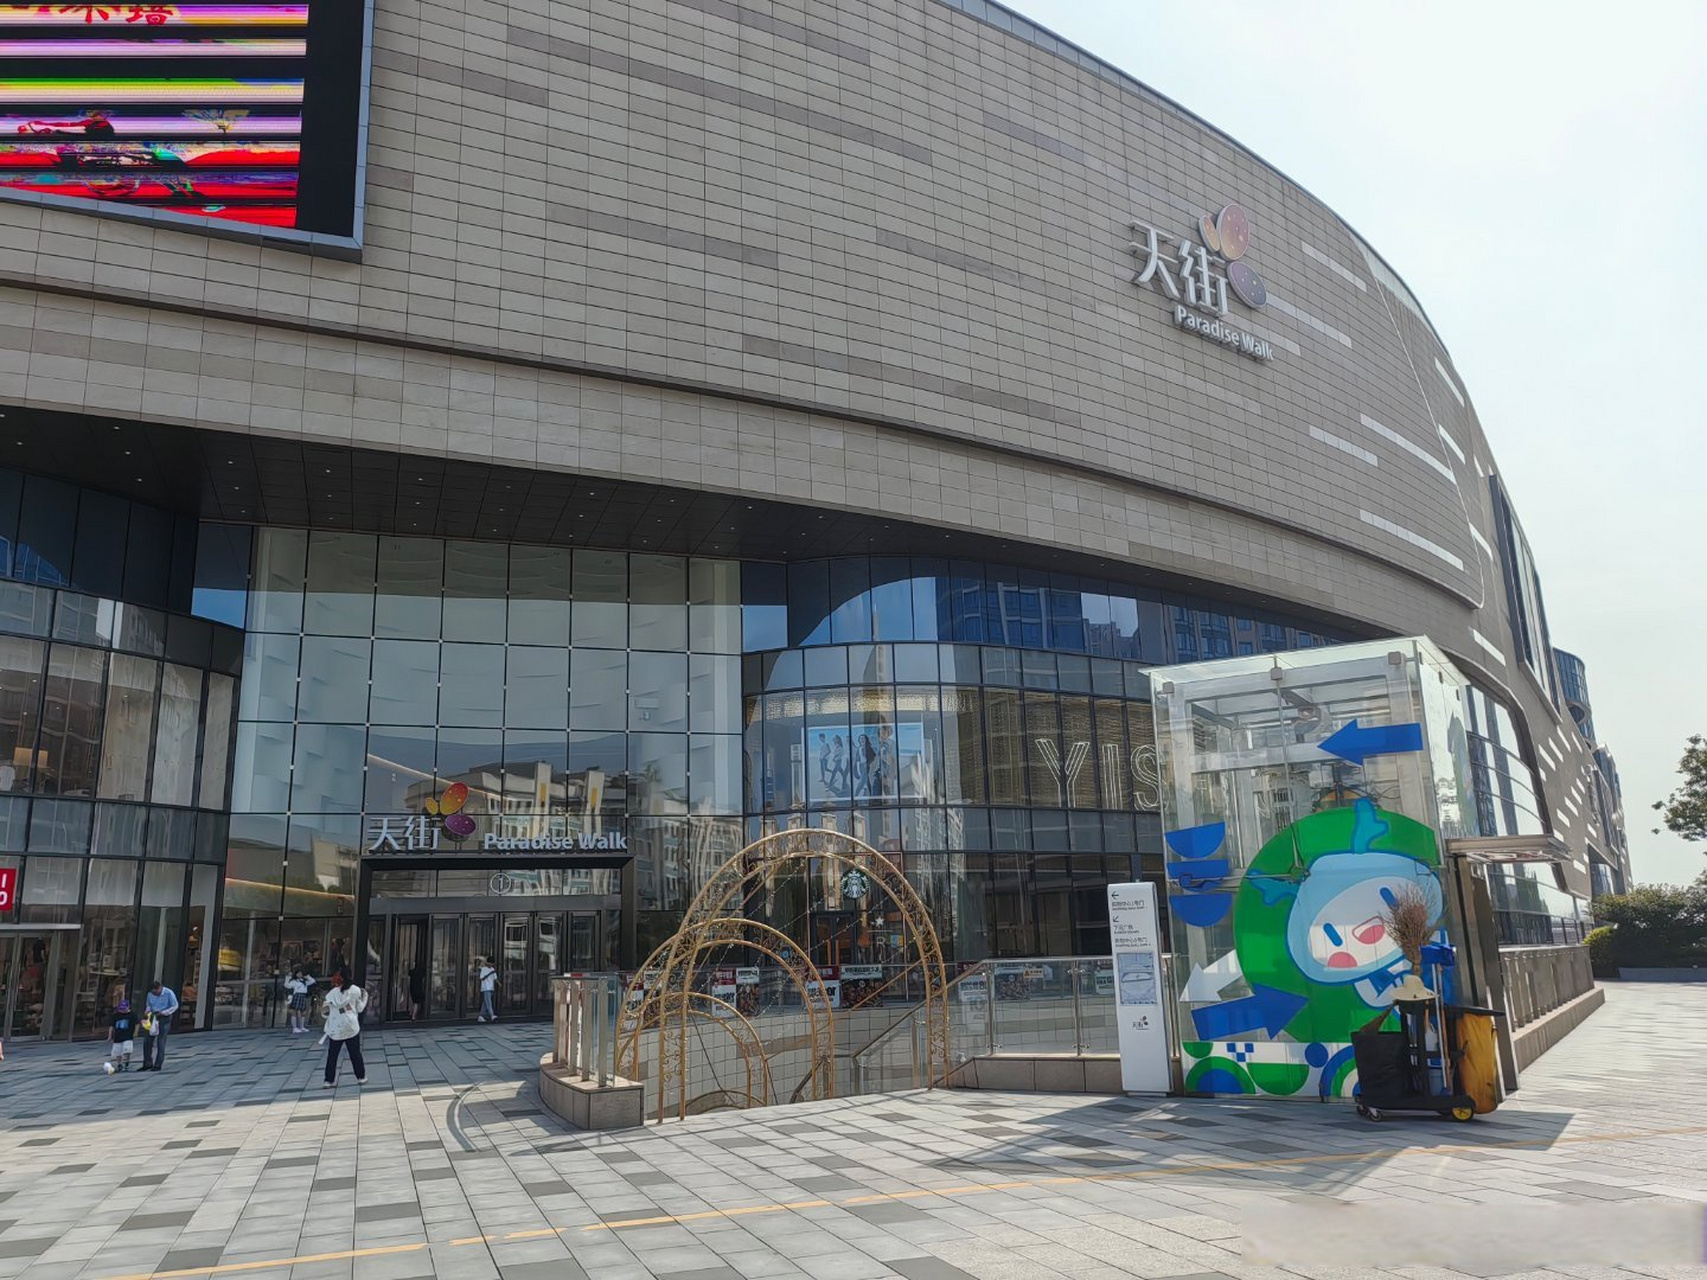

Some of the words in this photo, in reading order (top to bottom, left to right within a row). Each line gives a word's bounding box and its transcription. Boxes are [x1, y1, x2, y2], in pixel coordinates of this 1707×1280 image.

[1129, 220, 1229, 317] 天街
[1174, 304, 1240, 347] Paradise
[1241, 332, 1275, 362] Walk
[367, 815, 441, 851] 天街
[484, 832, 574, 851] Paradise
[577, 831, 628, 850] Walk
